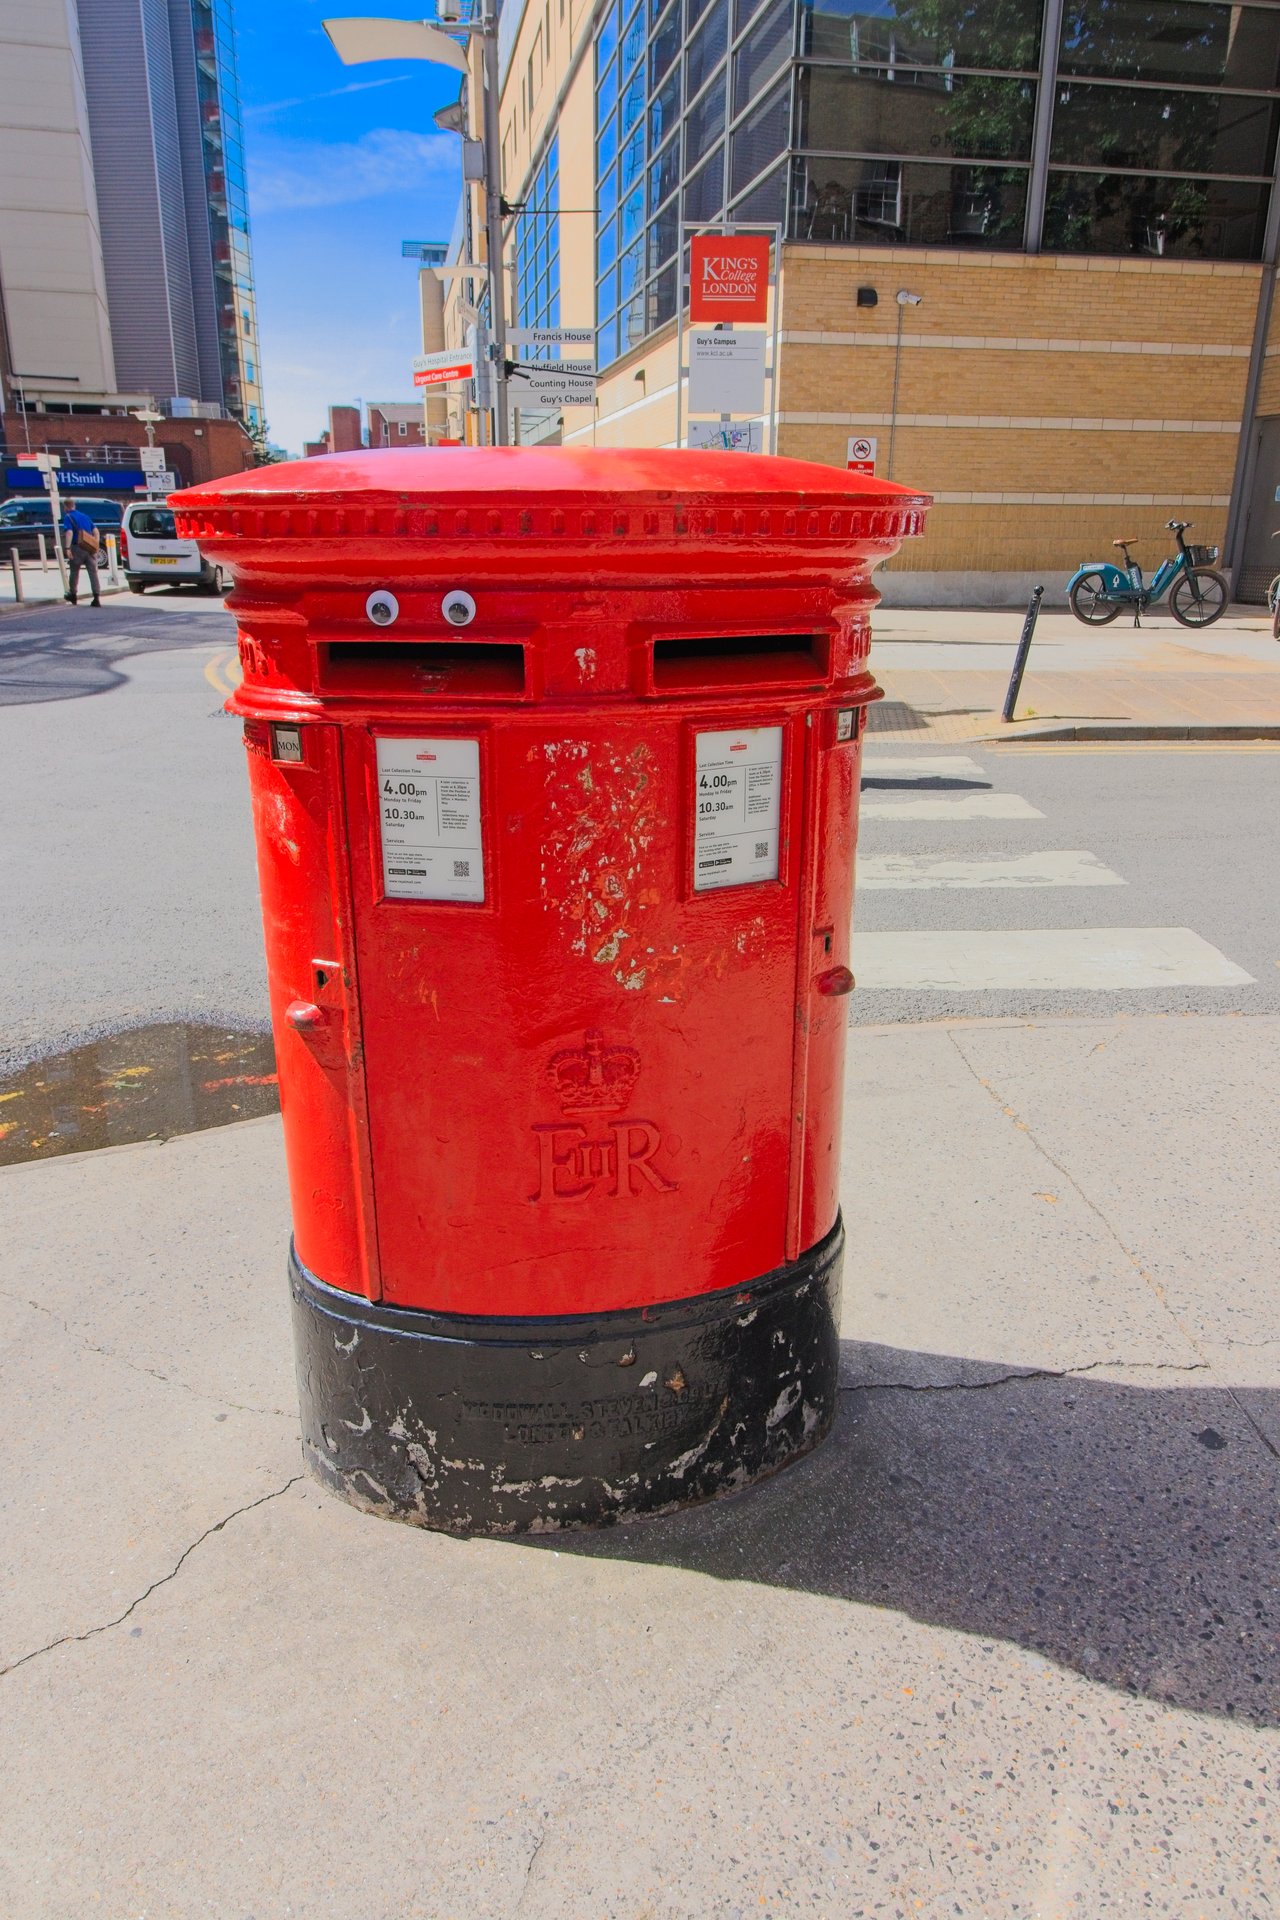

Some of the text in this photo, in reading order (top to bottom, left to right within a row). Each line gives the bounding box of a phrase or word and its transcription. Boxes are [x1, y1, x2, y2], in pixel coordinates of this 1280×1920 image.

[702, 257, 758, 280] KING'S
[720, 270, 757, 283] College
[702, 283, 757, 294] LONDON
[533, 332, 592, 341] Francis House
[696, 338, 737, 346] Guy's Campus
[413, 352, 473, 369] Guy's Hospital Entrance
[566, 363, 592, 372] House
[414, 370, 459, 385] Urgent Care Centre
[529, 379, 594, 389] Counting House
[540, 394, 592, 405] Guy's Chapel
[278, 741, 299, 751] MON
[699, 774, 738, 789] 4.00pm
[383, 779, 428, 797] 4.00pm
[407, 797, 422, 805] Friday
[699, 801, 734, 815] 10.30am
[384, 807, 425, 821] 10.30am
[385, 821, 405, 829] Saturday
